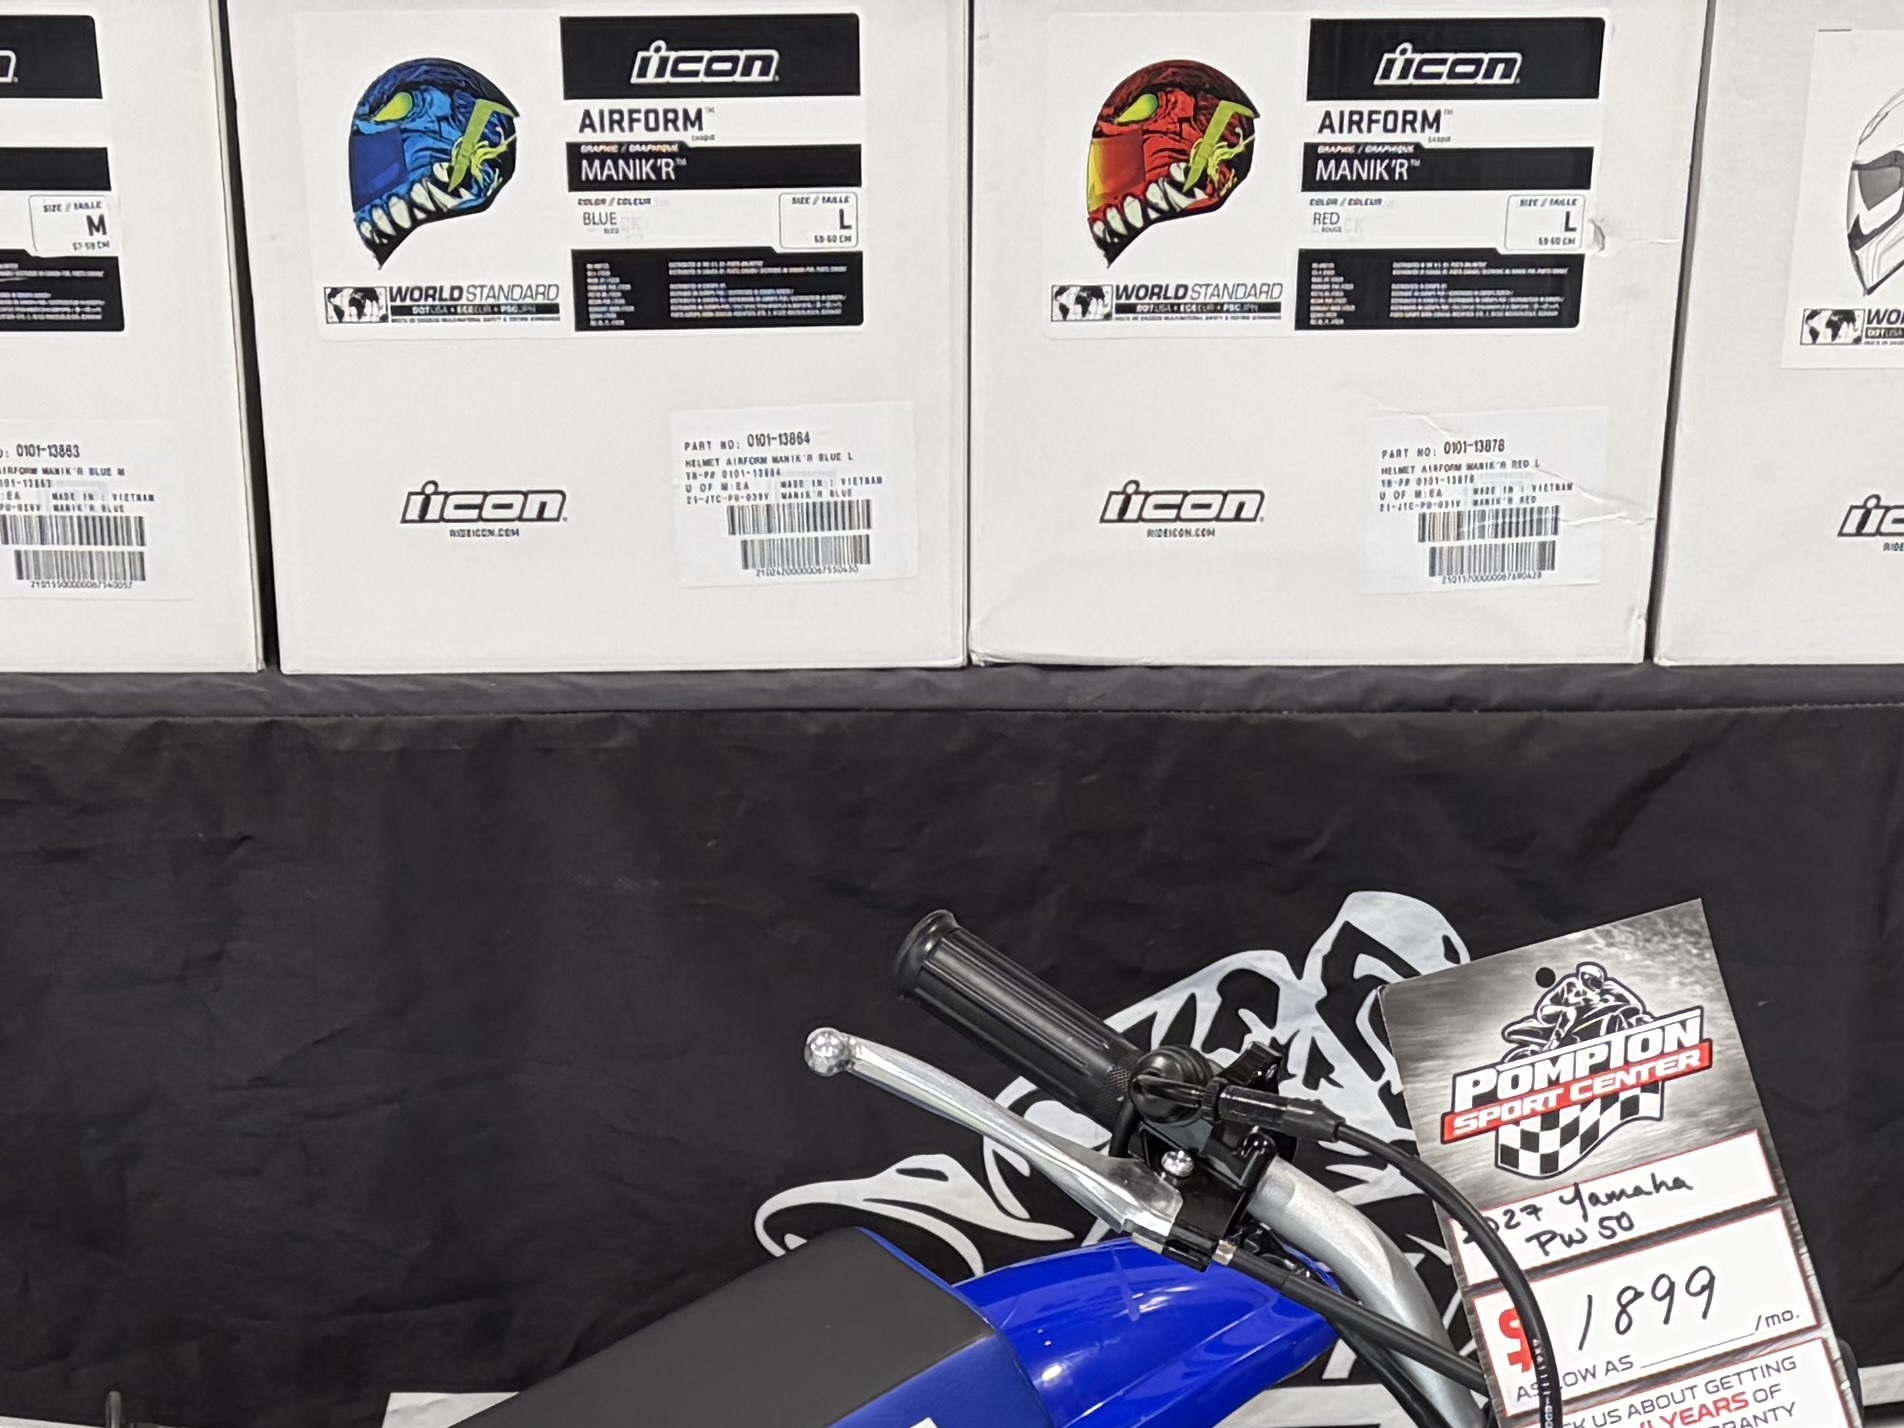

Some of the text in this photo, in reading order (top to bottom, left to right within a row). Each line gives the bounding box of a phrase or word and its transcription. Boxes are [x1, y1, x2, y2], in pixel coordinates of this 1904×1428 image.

[86, 214, 107, 236] M
[583, 212, 617, 226] BLUE
[839, 208, 853, 230] L
[1313, 212, 1340, 225] RED
[1563, 211, 1577, 232] L
[389, 284, 560, 303] WORLD STANDARD
[1115, 282, 1284, 300] WORLD STANDARD
[684, 440, 712, 451] PART
[747, 431, 811, 448] 0101-13864
[1381, 448, 1409, 459] PART
[450, 528, 519, 538] RIDEICON.COM
[1147, 528, 1216, 538] RIDEICON.COM
[1453, 1010, 1703, 1112] POMPTON
[1451, 1050, 1702, 1138] SPORT CENTER
[1559, 1173, 1693, 1223] Yamaha
[1579, 1265, 1716, 1351] 1899
[1559, 1364, 1597, 1391] OW
[1605, 1355, 1634, 1377] AS
[1754, 1312, 1800, 1332] /mo.
[1593, 1409, 1622, 1428] US
[1627, 1385, 1698, 1421] ABOUT
[1705, 1356, 1797, 1394] GETTING
[1752, 1384, 1783, 1404] OF
